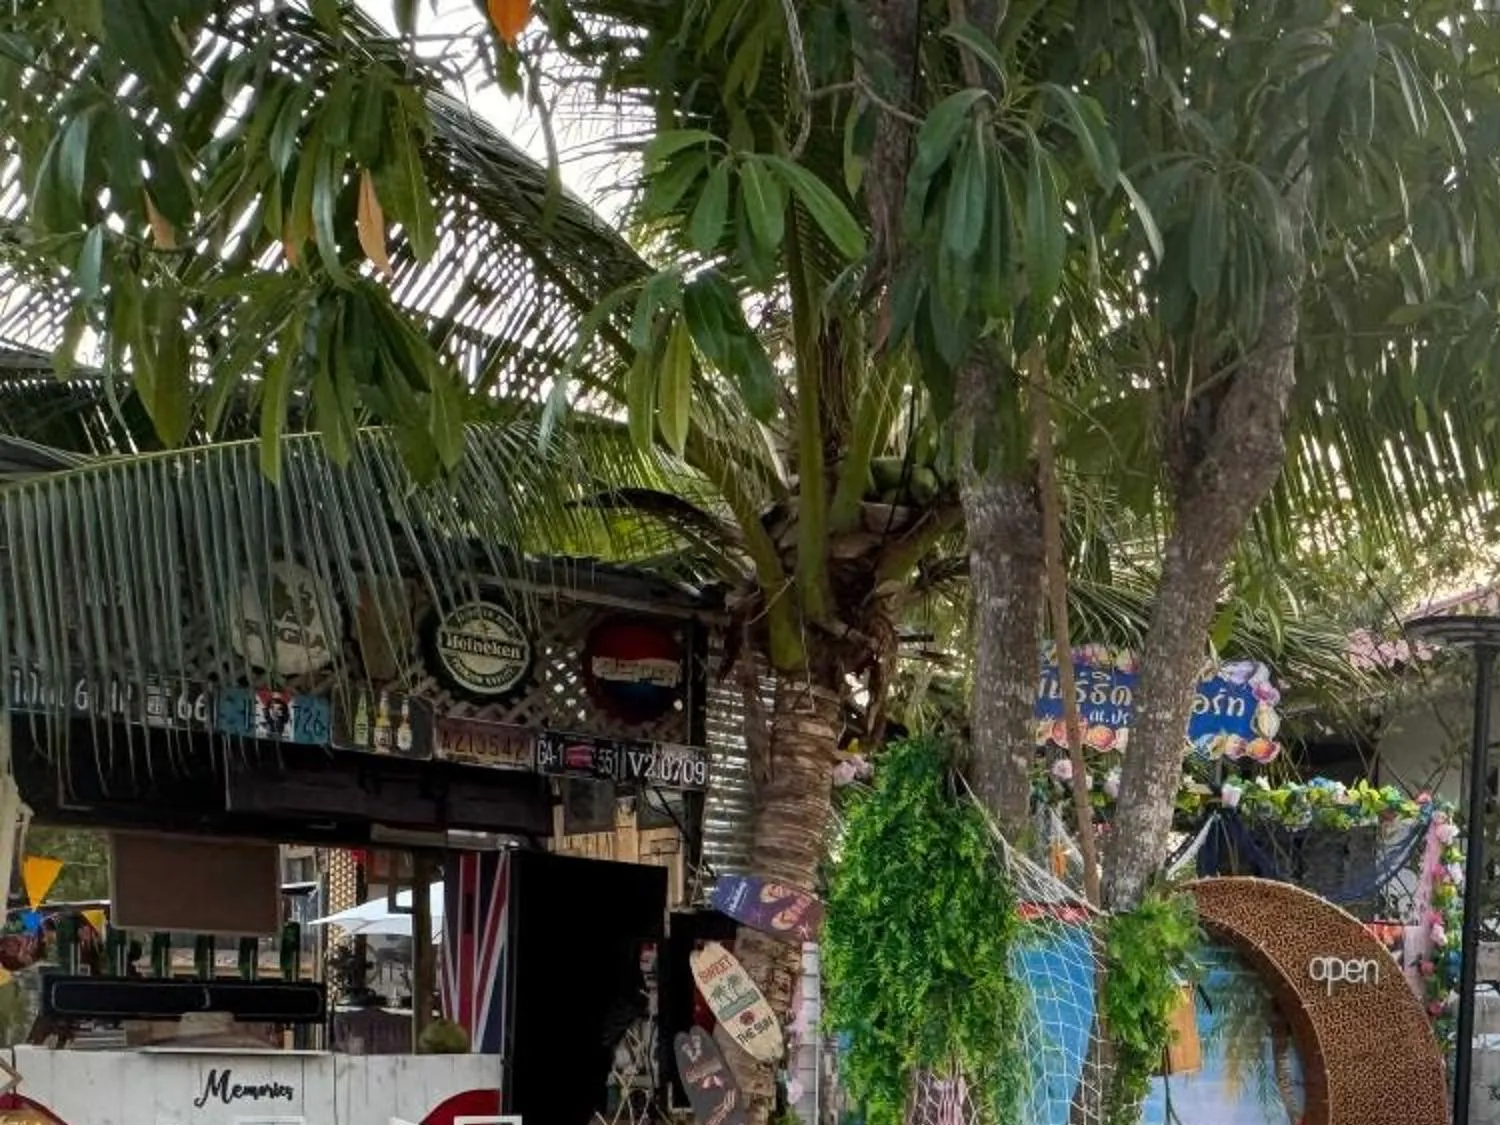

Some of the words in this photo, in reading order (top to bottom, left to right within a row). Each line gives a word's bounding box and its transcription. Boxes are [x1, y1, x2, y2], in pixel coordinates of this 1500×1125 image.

[446, 631, 521, 660] Heineken
[1309, 956, 1379, 997] open
[194, 1069, 293, 1107] Memories
